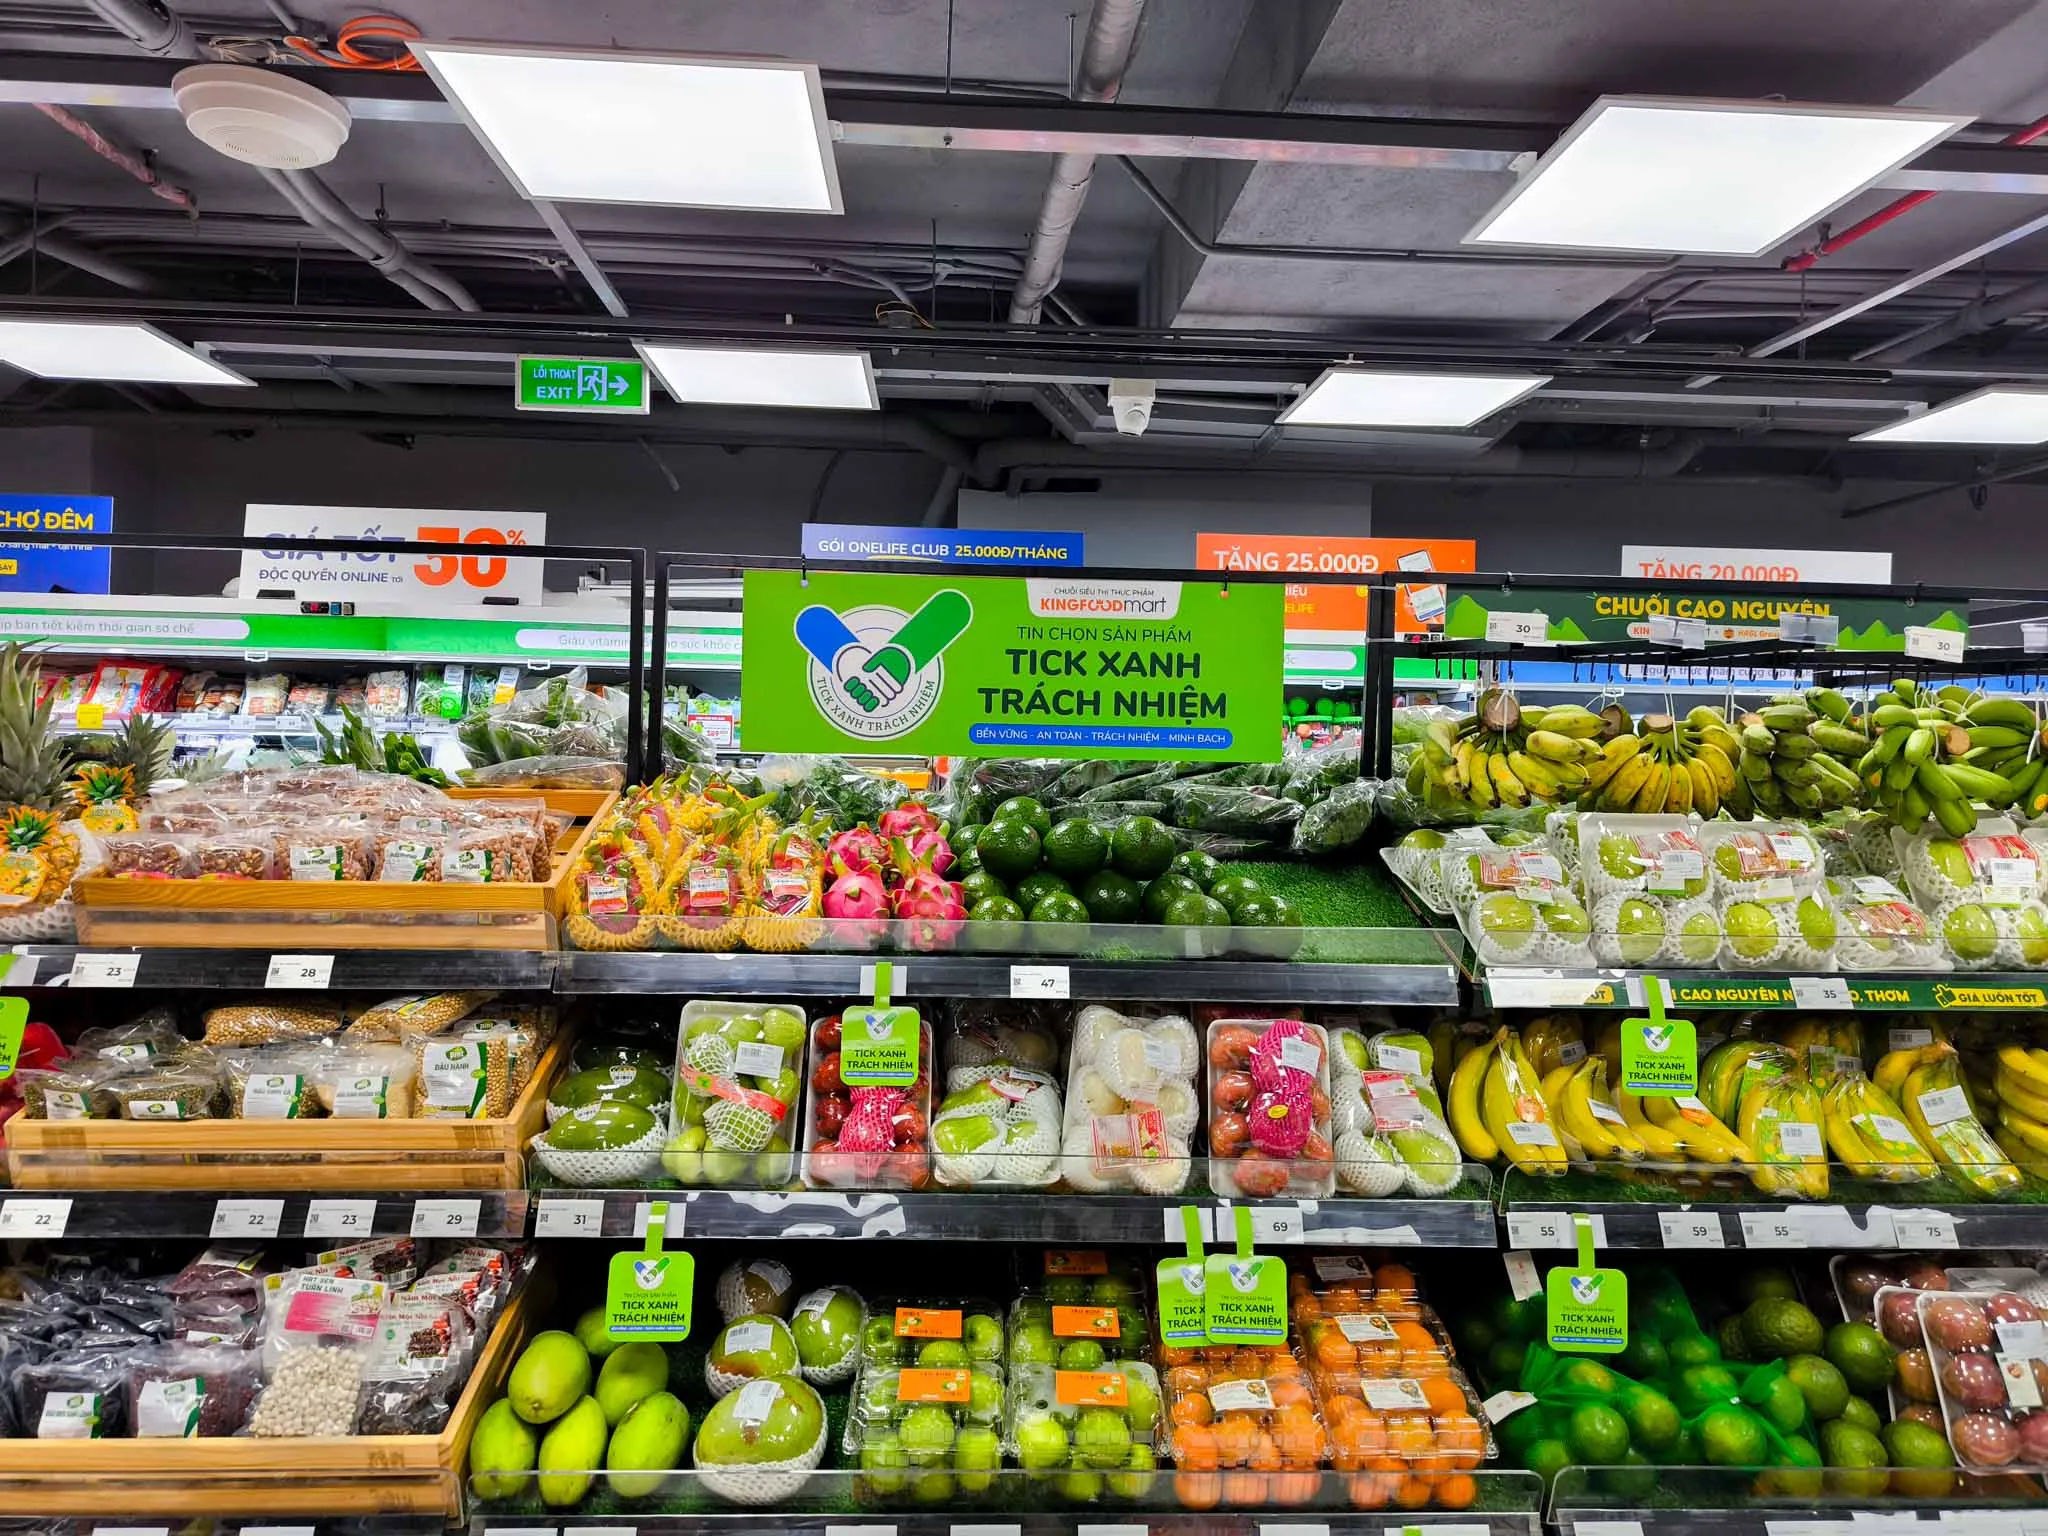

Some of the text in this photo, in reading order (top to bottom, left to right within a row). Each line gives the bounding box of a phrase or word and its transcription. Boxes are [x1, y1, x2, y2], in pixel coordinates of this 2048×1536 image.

[536, 386, 573, 399] EXIT
[43, 507, 94, 531] ĐÊM
[818, 536, 844, 553] GÓI
[848, 541, 908, 555] ONELIFE
[912, 544, 949, 556] CLUB
[1285, 552, 1379, 573] 25.000Đ
[340, 571, 388, 584] ONLINE
[1676, 598, 1726, 620] CAO
[1516, 624, 1531, 633] 30
[1017, 624, 1192, 645] TIN CHỌN SẢN PHẨM
[1936, 642, 1950, 651] 30
[1005, 649, 1200, 679] TICK XANH
[816, 676, 834, 705] TICK
[831, 703, 864, 730] XANH
[866, 714, 910, 732] TRÁCH
[978, 682, 1227, 726] TRÁCH NHIỆM
[1036, 730, 1052, 740] AN
[1054, 728, 1082, 741] TOÀN
[1091, 730, 1125, 742] TRÁCH
[1168, 733, 1194, 743] MINH
[106, 967, 122, 976] 23
[300, 968, 316, 978] 28
[1040, 978, 1056, 988] 47
[1680, 988, 1713, 1001] CAO
[1716, 986, 1779, 1002] NGUYÊN
[1864, 990, 1910, 1003] THƠM
[1824, 990, 1836, 998] 35
[854, 1050, 906, 1058] TICK XANH
[847, 1058, 880, 1070] TRÁCH
[1635, 1062, 1686, 1070] TICK XANH
[1628, 1071, 1660, 1080] TRÁCH
[34, 1214, 51, 1224] 22
[248, 1214, 264, 1224] 22
[342, 1214, 358, 1225] 23
[446, 1214, 462, 1226] 29
[574, 1214, 587, 1225] 31
[1272, 1222, 1288, 1232] 69
[1540, 1226, 1555, 1237] 55
[1692, 1226, 1708, 1237] 59
[1774, 1226, 1788, 1237] 55
[1926, 1226, 1941, 1238] 75
[620, 1300, 678, 1310] TICK XANH
[1174, 1306, 1196, 1315] TICK
[1220, 1303, 1274, 1313] TICK XANH
[612, 1312, 685, 1324] TRÁCH NHIỆM
[1167, 1318, 1201, 1328] TRÁCH
[1212, 1314, 1282, 1328] TRÁCH NHIỆM
[1560, 1313, 1614, 1323] TICK XANH
